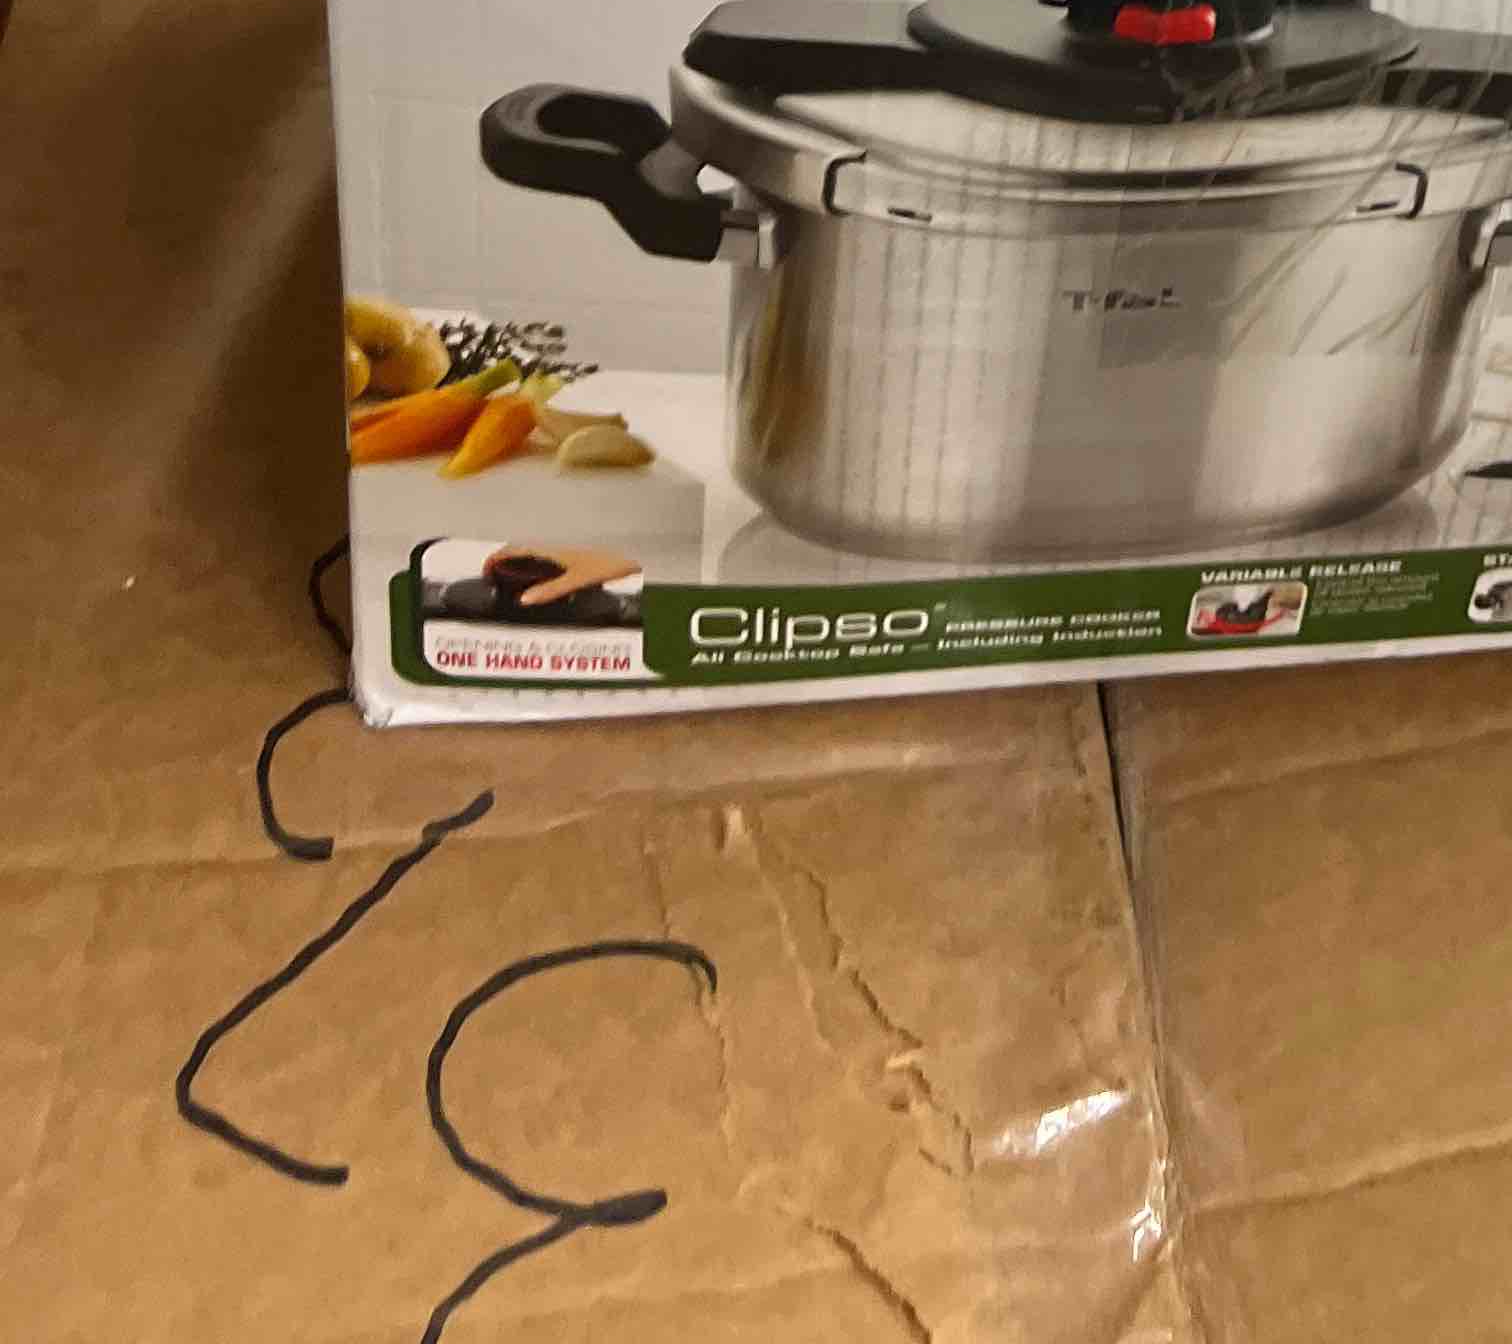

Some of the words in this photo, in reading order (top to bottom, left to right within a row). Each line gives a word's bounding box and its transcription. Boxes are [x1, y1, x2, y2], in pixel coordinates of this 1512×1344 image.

[1200, 564, 1303, 584] VARIABLE
[1308, 560, 1402, 578] RELEASE
[689, 606, 930, 656] Clipso
[435, 651, 478, 669] ONE
[484, 653, 544, 671] HAND
[550, 654, 632, 672] SYSTEM
[690, 650, 724, 666] All
[936, 630, 1044, 651] Including
